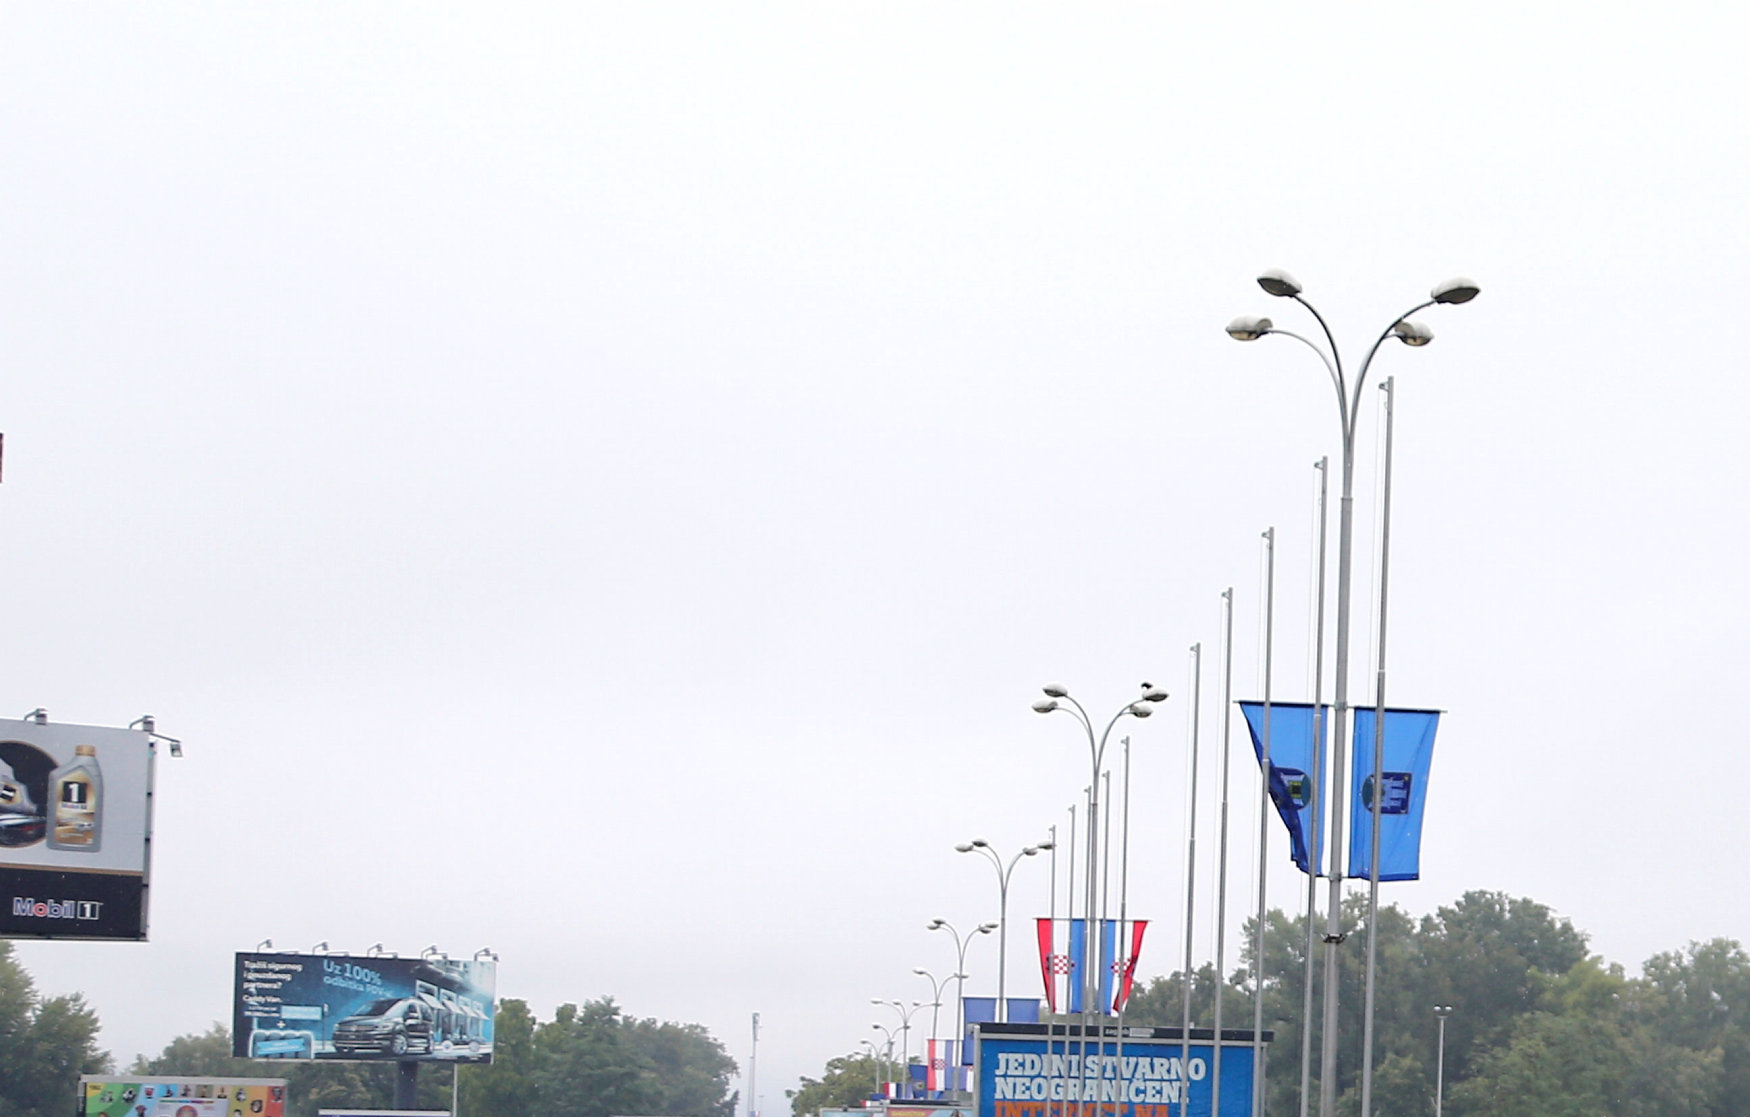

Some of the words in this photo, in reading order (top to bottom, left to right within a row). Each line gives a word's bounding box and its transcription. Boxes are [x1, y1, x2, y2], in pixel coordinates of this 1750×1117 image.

[13, 896, 75, 919] Mobil
[323, 959, 342, 975] Uz
[343, 963, 382, 985] 100%
[994, 1052, 1080, 1076] JEDINI
[1085, 1054, 1207, 1081] STVARNO
